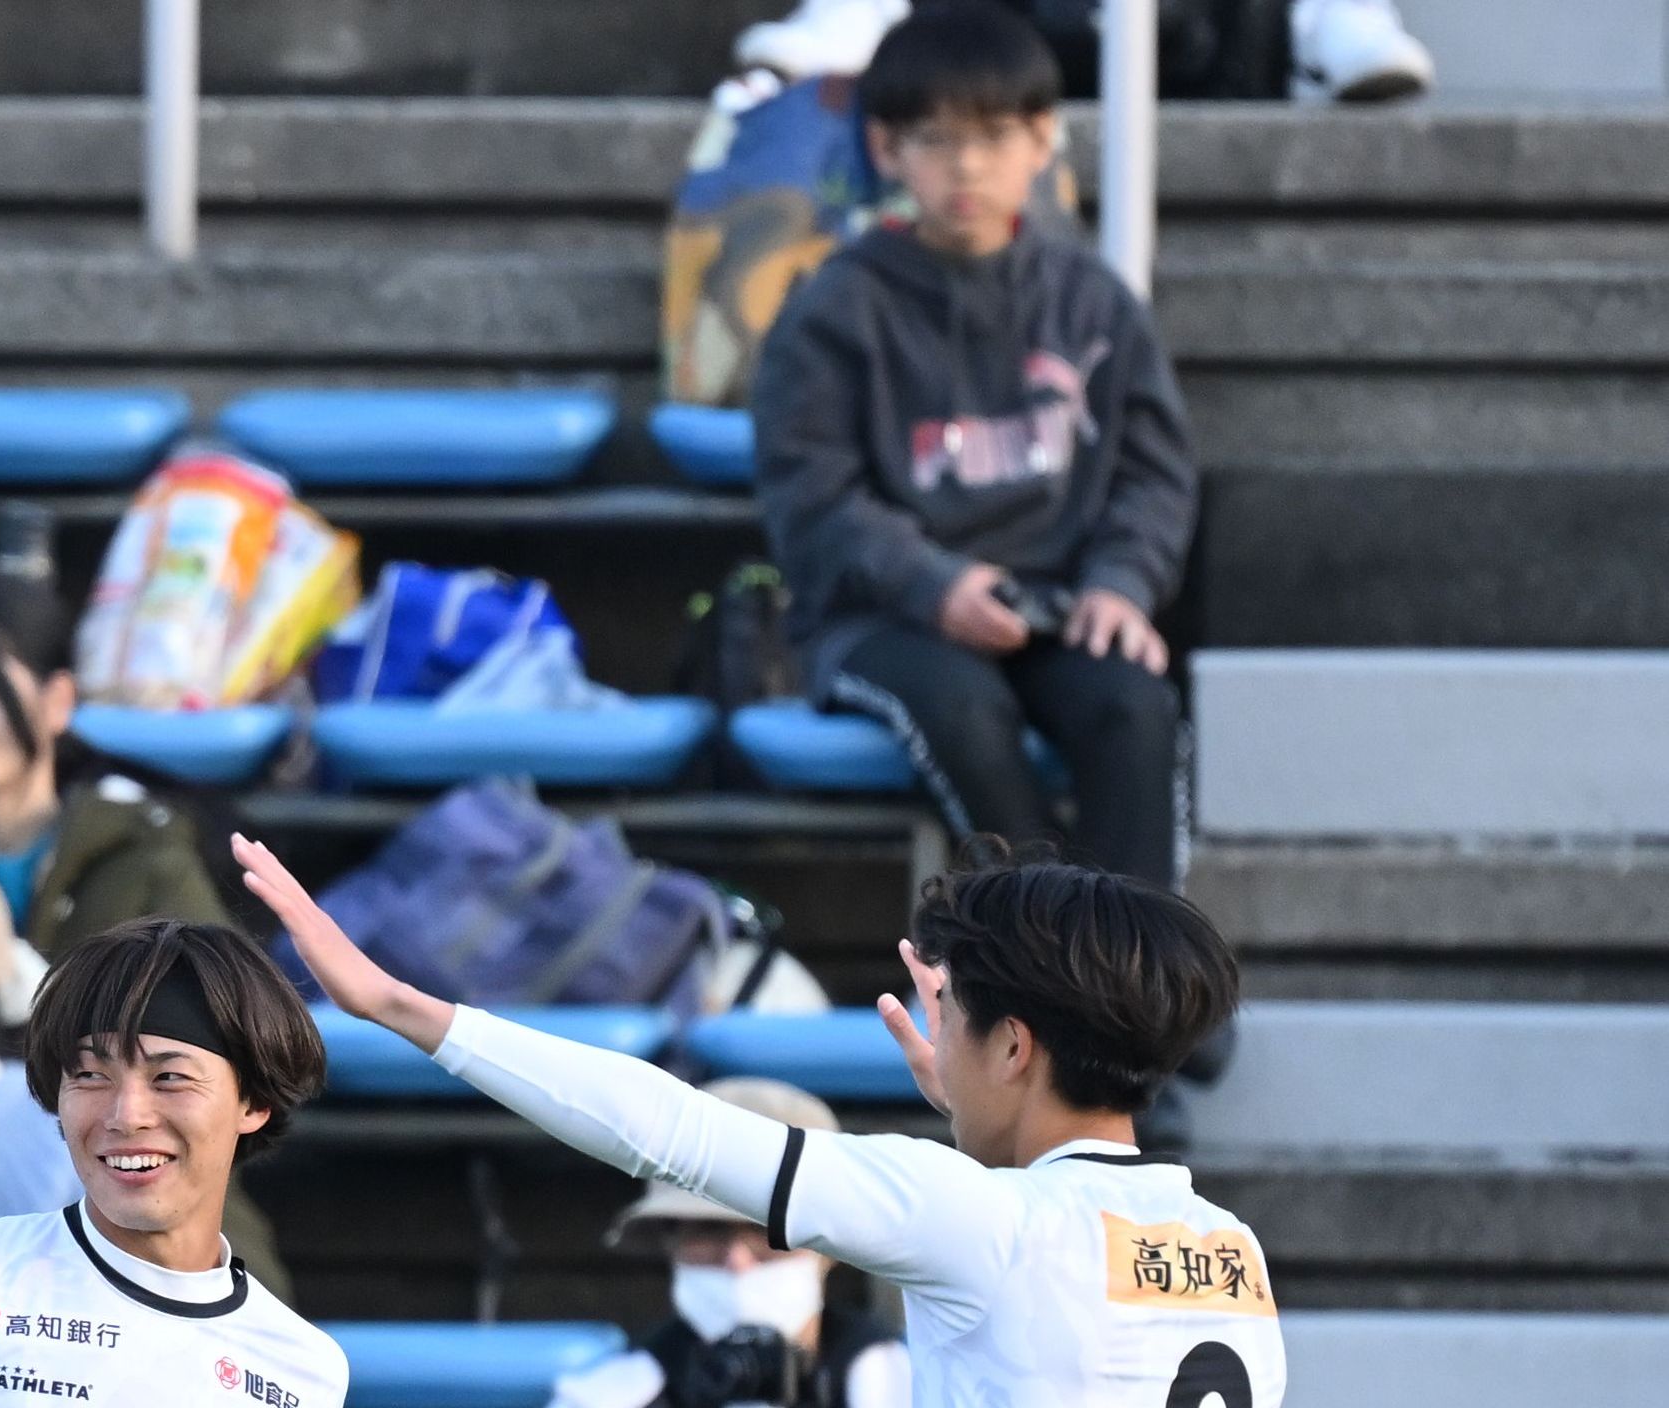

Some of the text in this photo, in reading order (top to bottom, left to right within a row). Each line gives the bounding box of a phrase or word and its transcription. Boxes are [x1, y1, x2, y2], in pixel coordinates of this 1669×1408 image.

[1131, 1238, 1252, 1300] 高知家
[5, 1314, 122, 1349] 高知銀行
